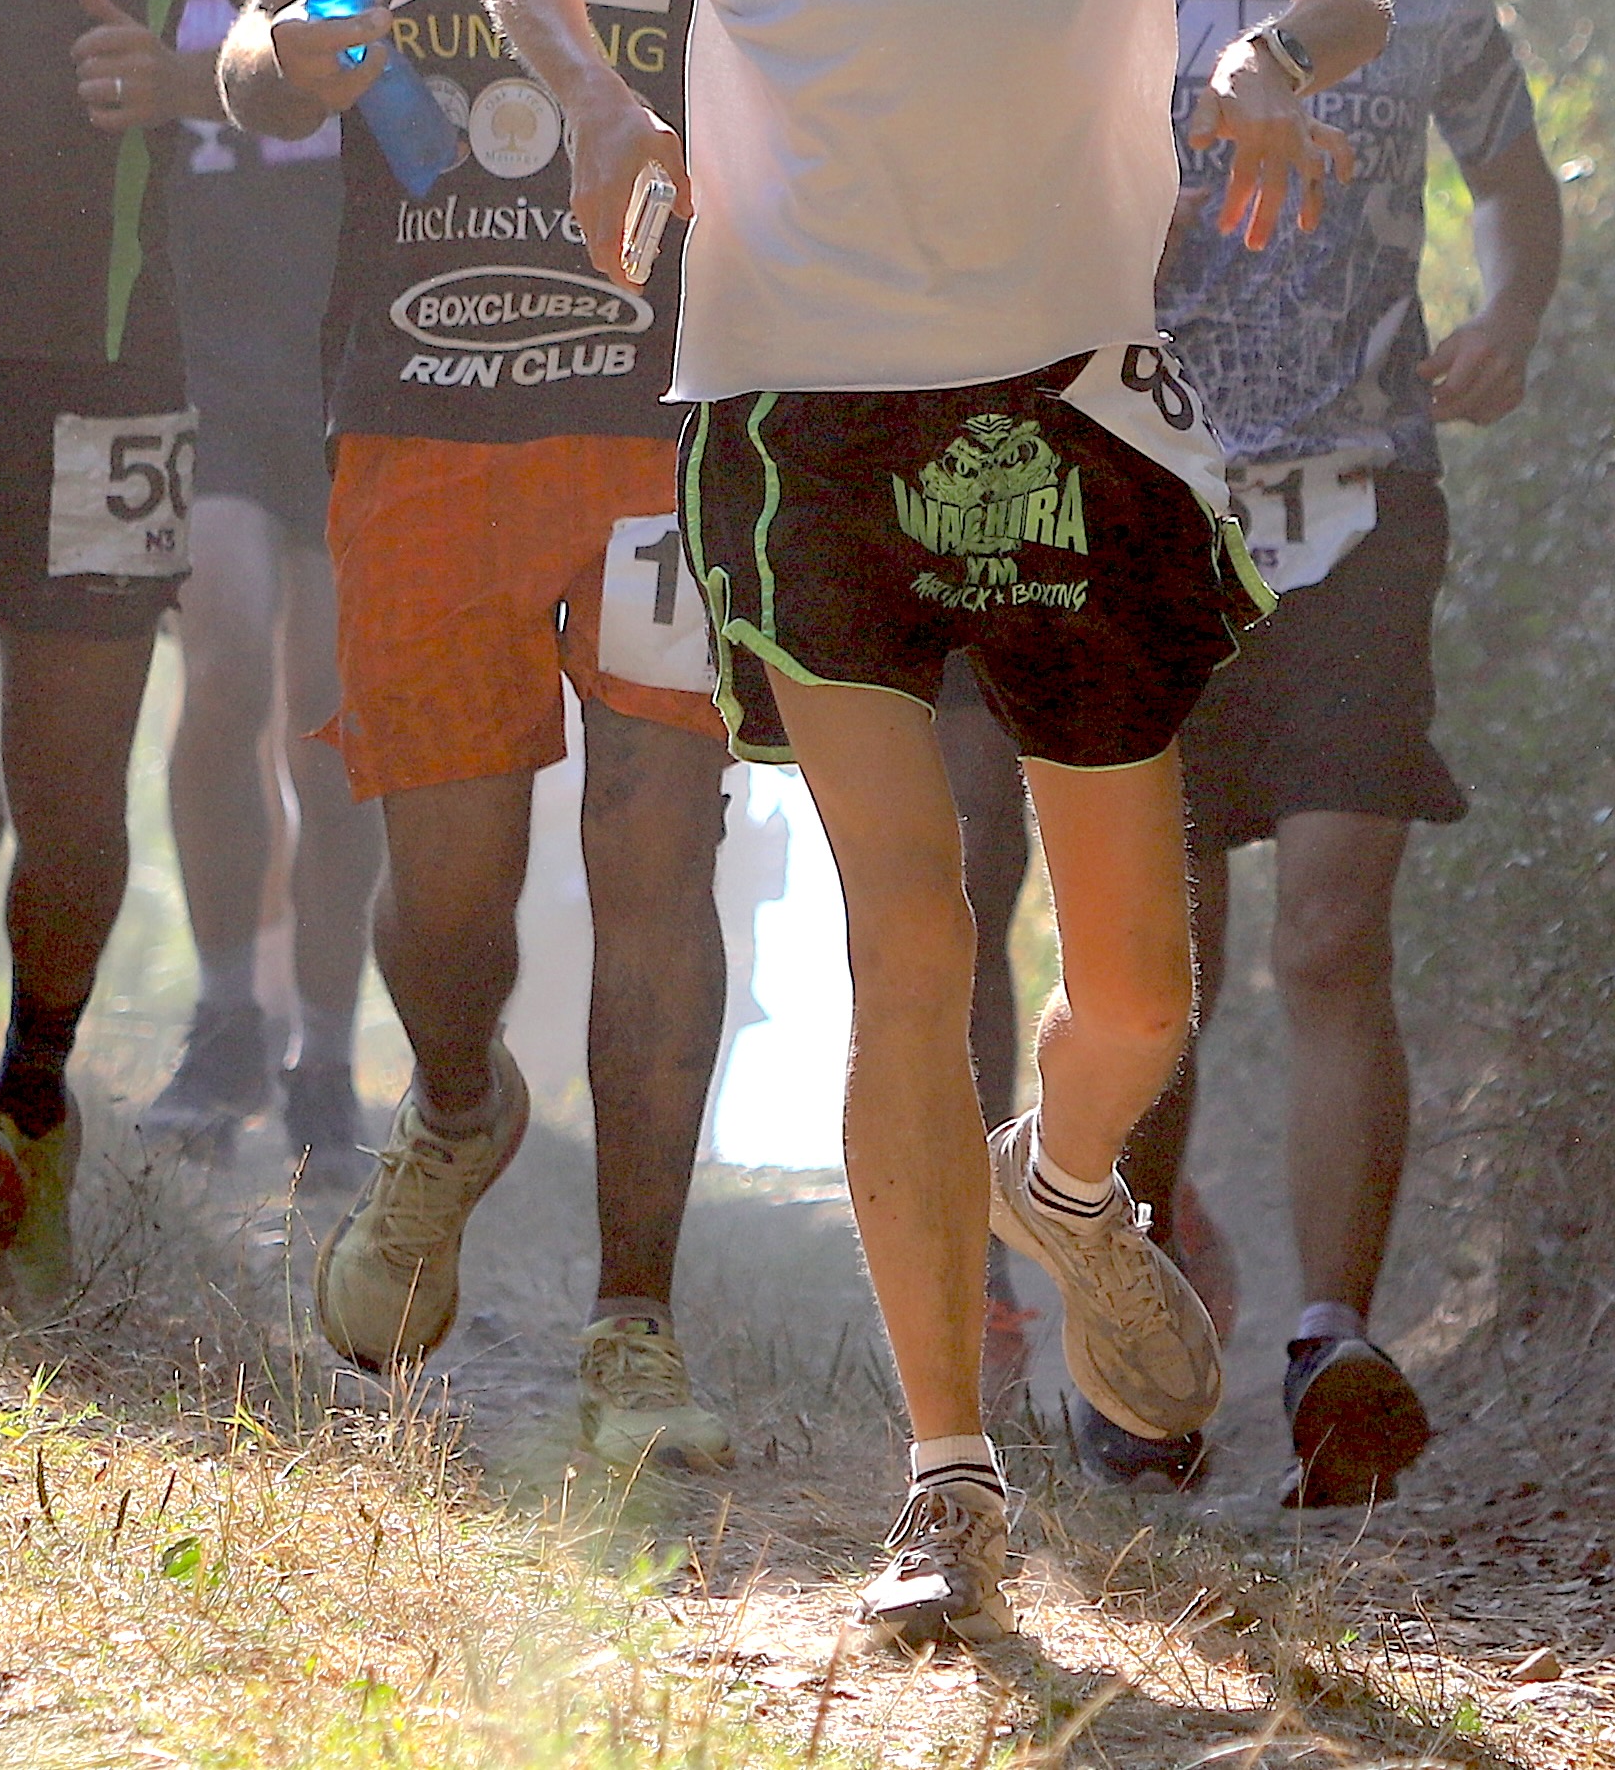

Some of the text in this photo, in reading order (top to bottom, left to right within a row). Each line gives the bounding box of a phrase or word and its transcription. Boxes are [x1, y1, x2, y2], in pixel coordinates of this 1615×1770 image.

[391, 12, 669, 73] RUNNG
[417, 291, 622, 329] BOXCLUB24
[399, 342, 637, 389] RUN CLUB
[1011, 580, 1089, 613] BOXING
